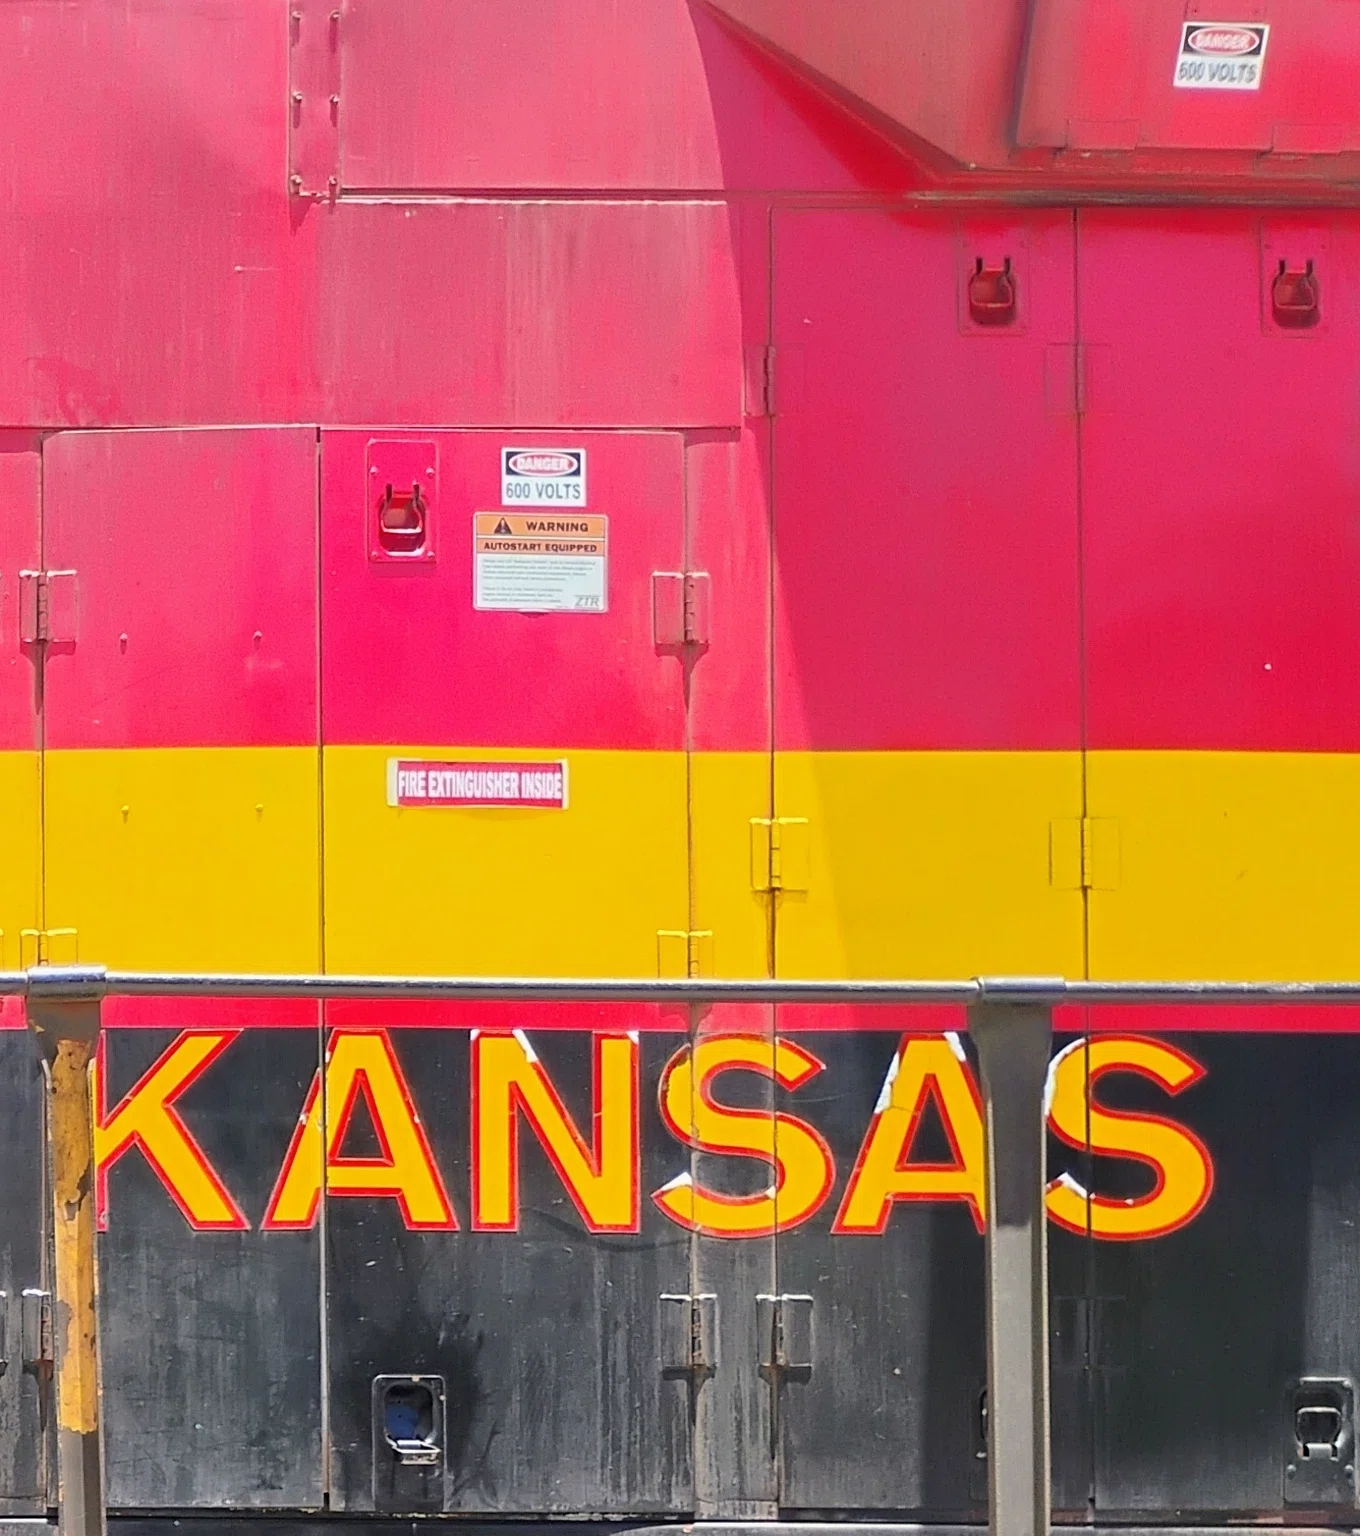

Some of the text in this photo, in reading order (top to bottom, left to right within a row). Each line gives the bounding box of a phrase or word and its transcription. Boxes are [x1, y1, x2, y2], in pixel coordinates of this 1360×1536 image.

[1178, 61, 1257, 84] 600 VOLTS
[517, 458, 569, 470] DANGER
[506, 483, 581, 499] 600 VOLTS
[526, 521, 589, 532] WARNING
[484, 542, 597, 553] AUTOSTART EQUIPPED
[398, 770, 562, 799] FIRE EXTINGUISHER INSIDE
[93, 1026, 1213, 1239] KANSAS
